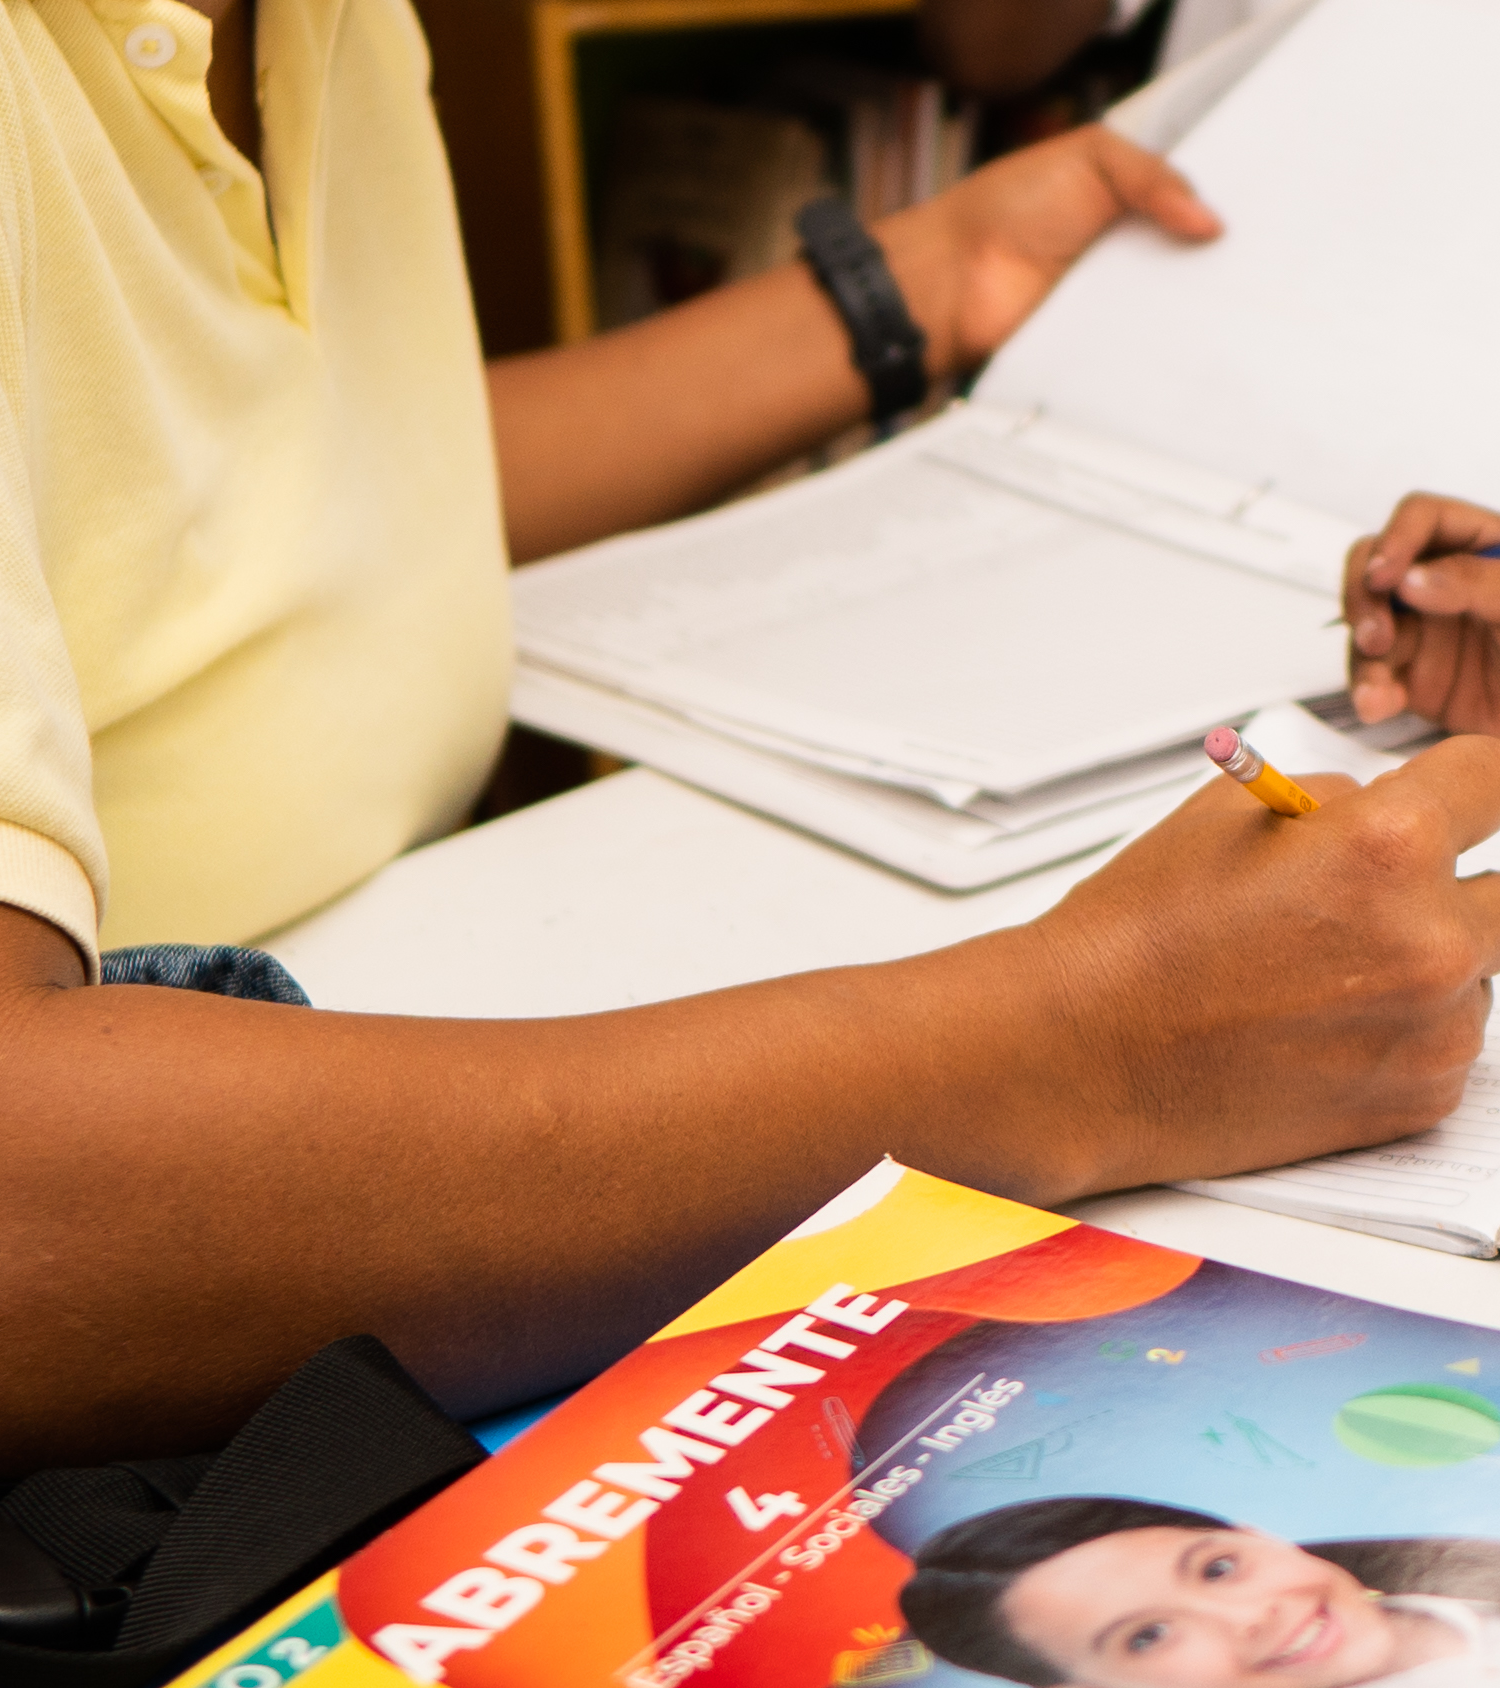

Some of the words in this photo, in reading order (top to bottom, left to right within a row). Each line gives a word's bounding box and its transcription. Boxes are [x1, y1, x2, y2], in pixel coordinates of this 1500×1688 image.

[370, 1282, 910, 1686] ABREMENTE
[622, 1581, 782, 1688] Español
[779, 1464, 924, 1571] Sociales
[918, 1376, 1026, 1453] Inglés
[724, 1484, 808, 1533] 4
